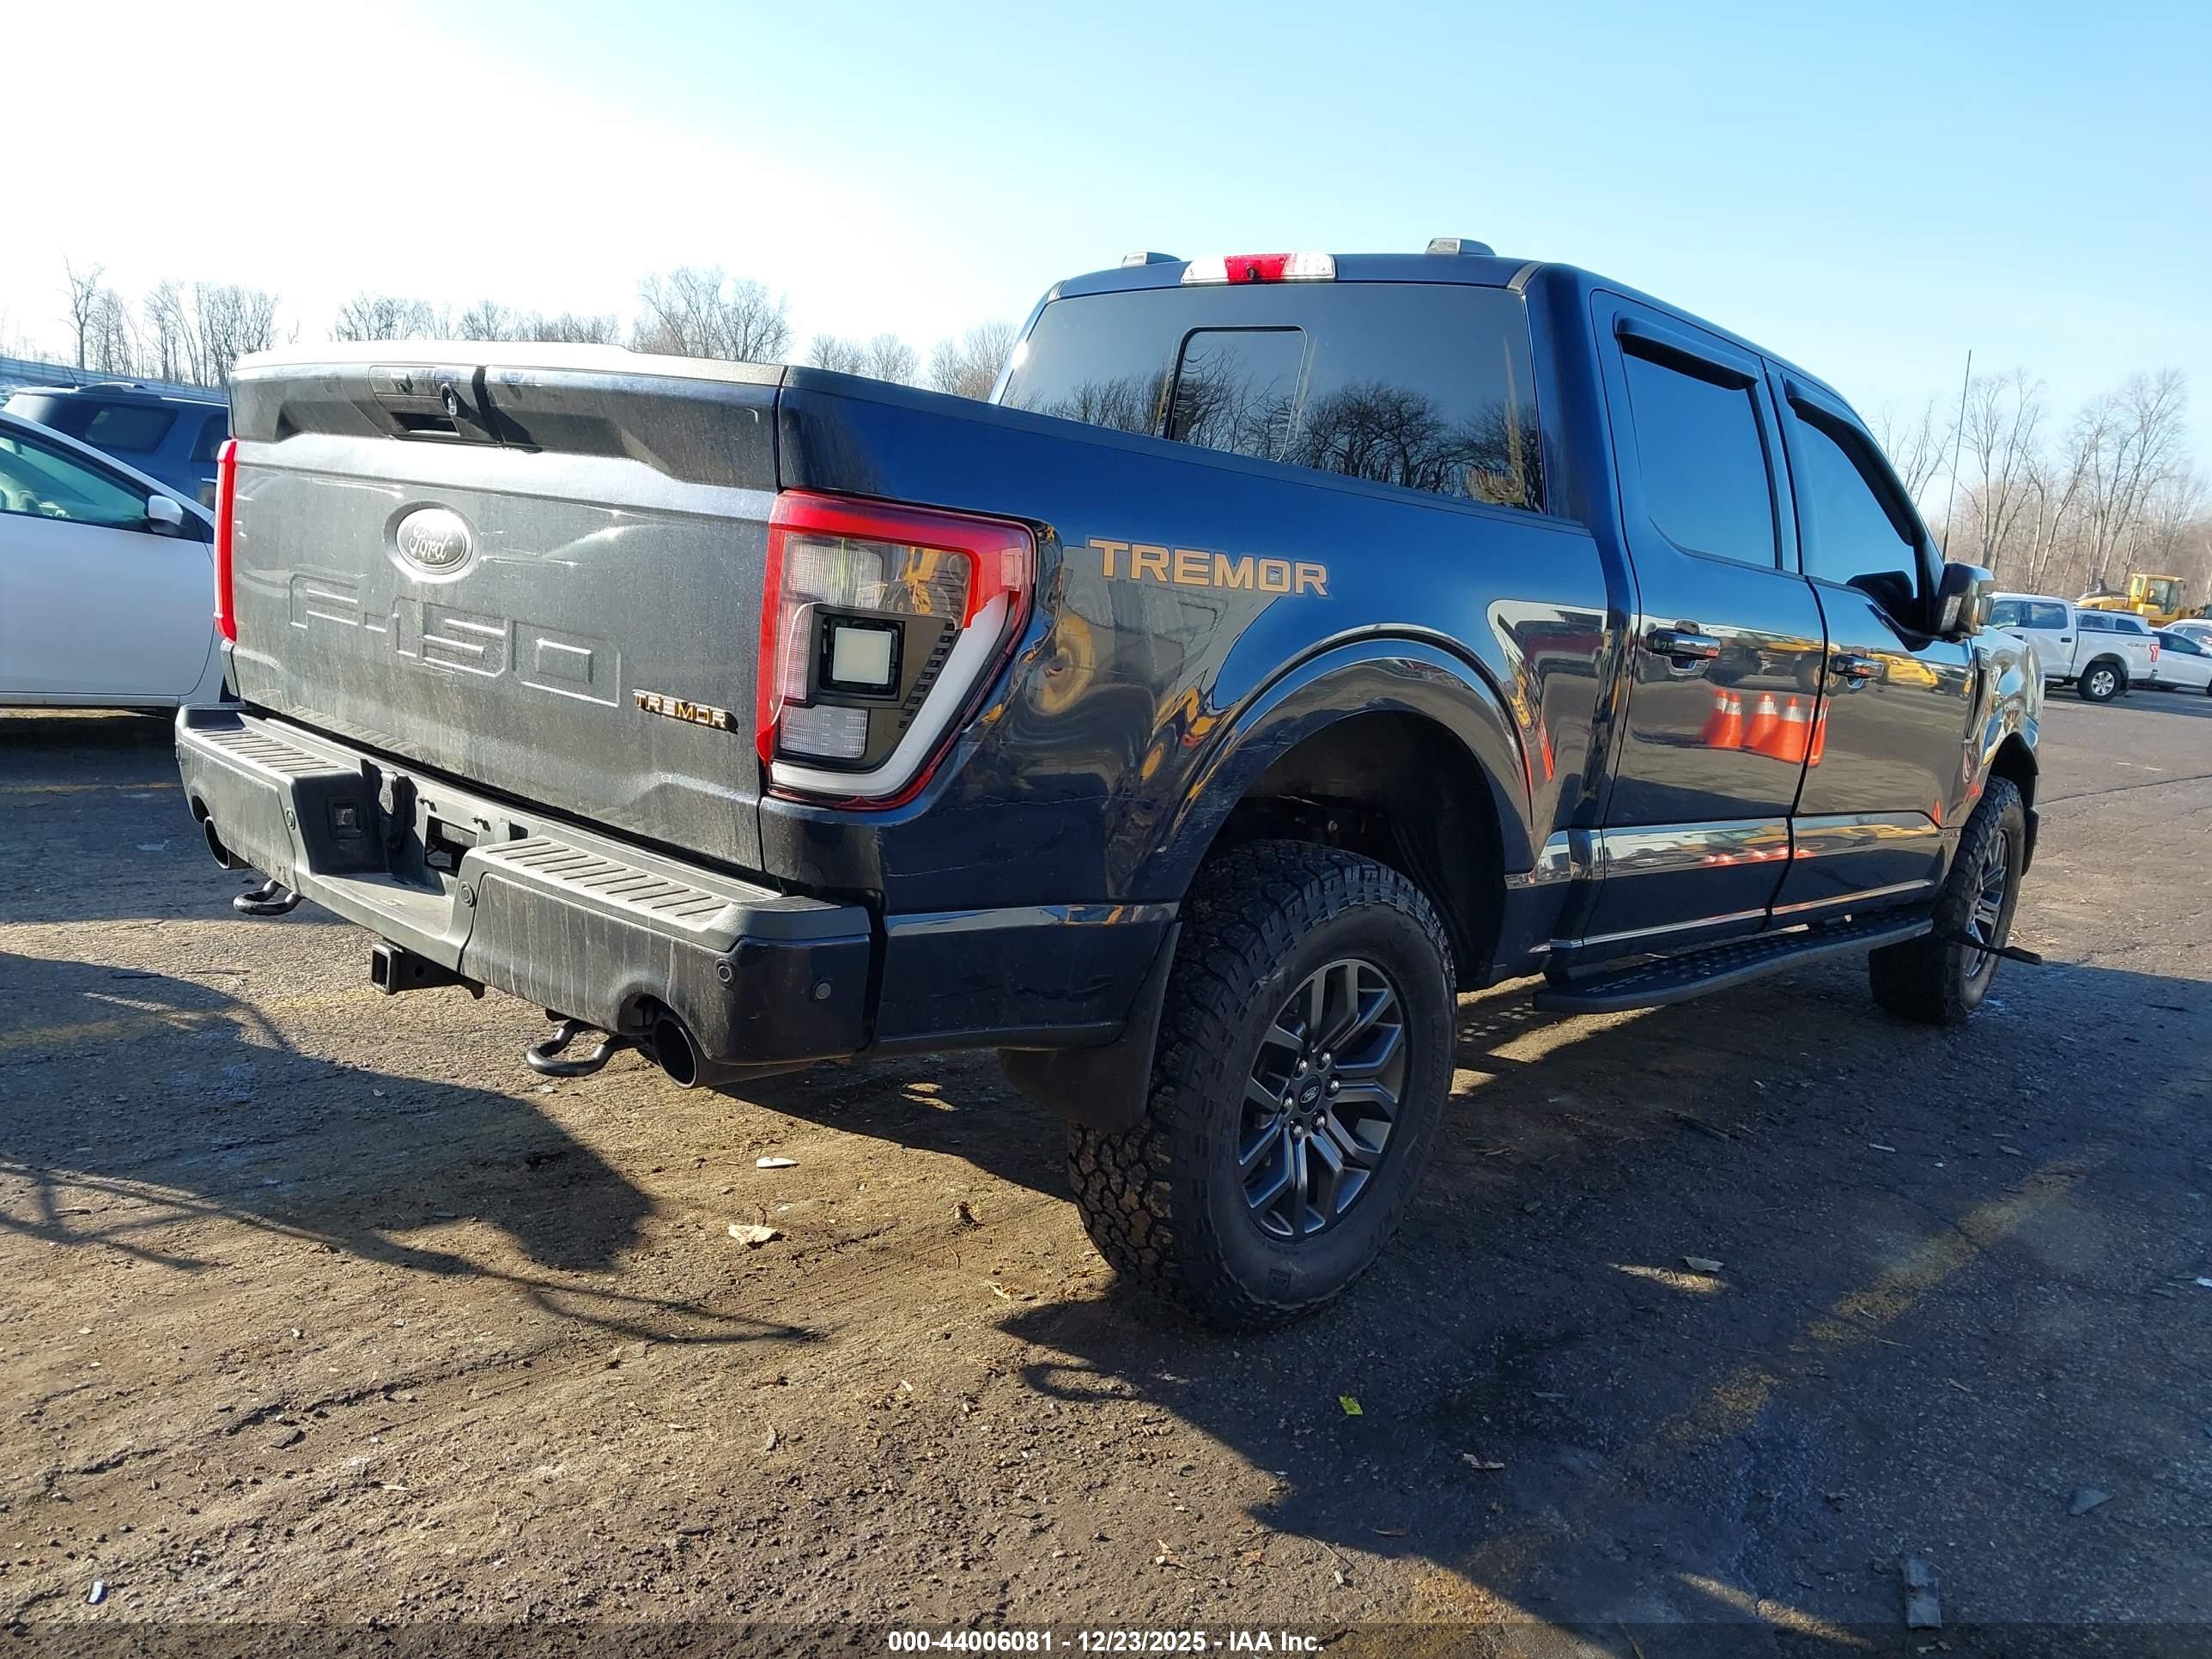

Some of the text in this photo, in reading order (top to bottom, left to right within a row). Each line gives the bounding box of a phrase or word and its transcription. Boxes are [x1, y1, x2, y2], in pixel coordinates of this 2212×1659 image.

[407, 520, 453, 561] Ford
[1088, 538, 1329, 596] TREMOR
[289, 574, 622, 708] F-150
[634, 690, 726, 728] TREMOR
